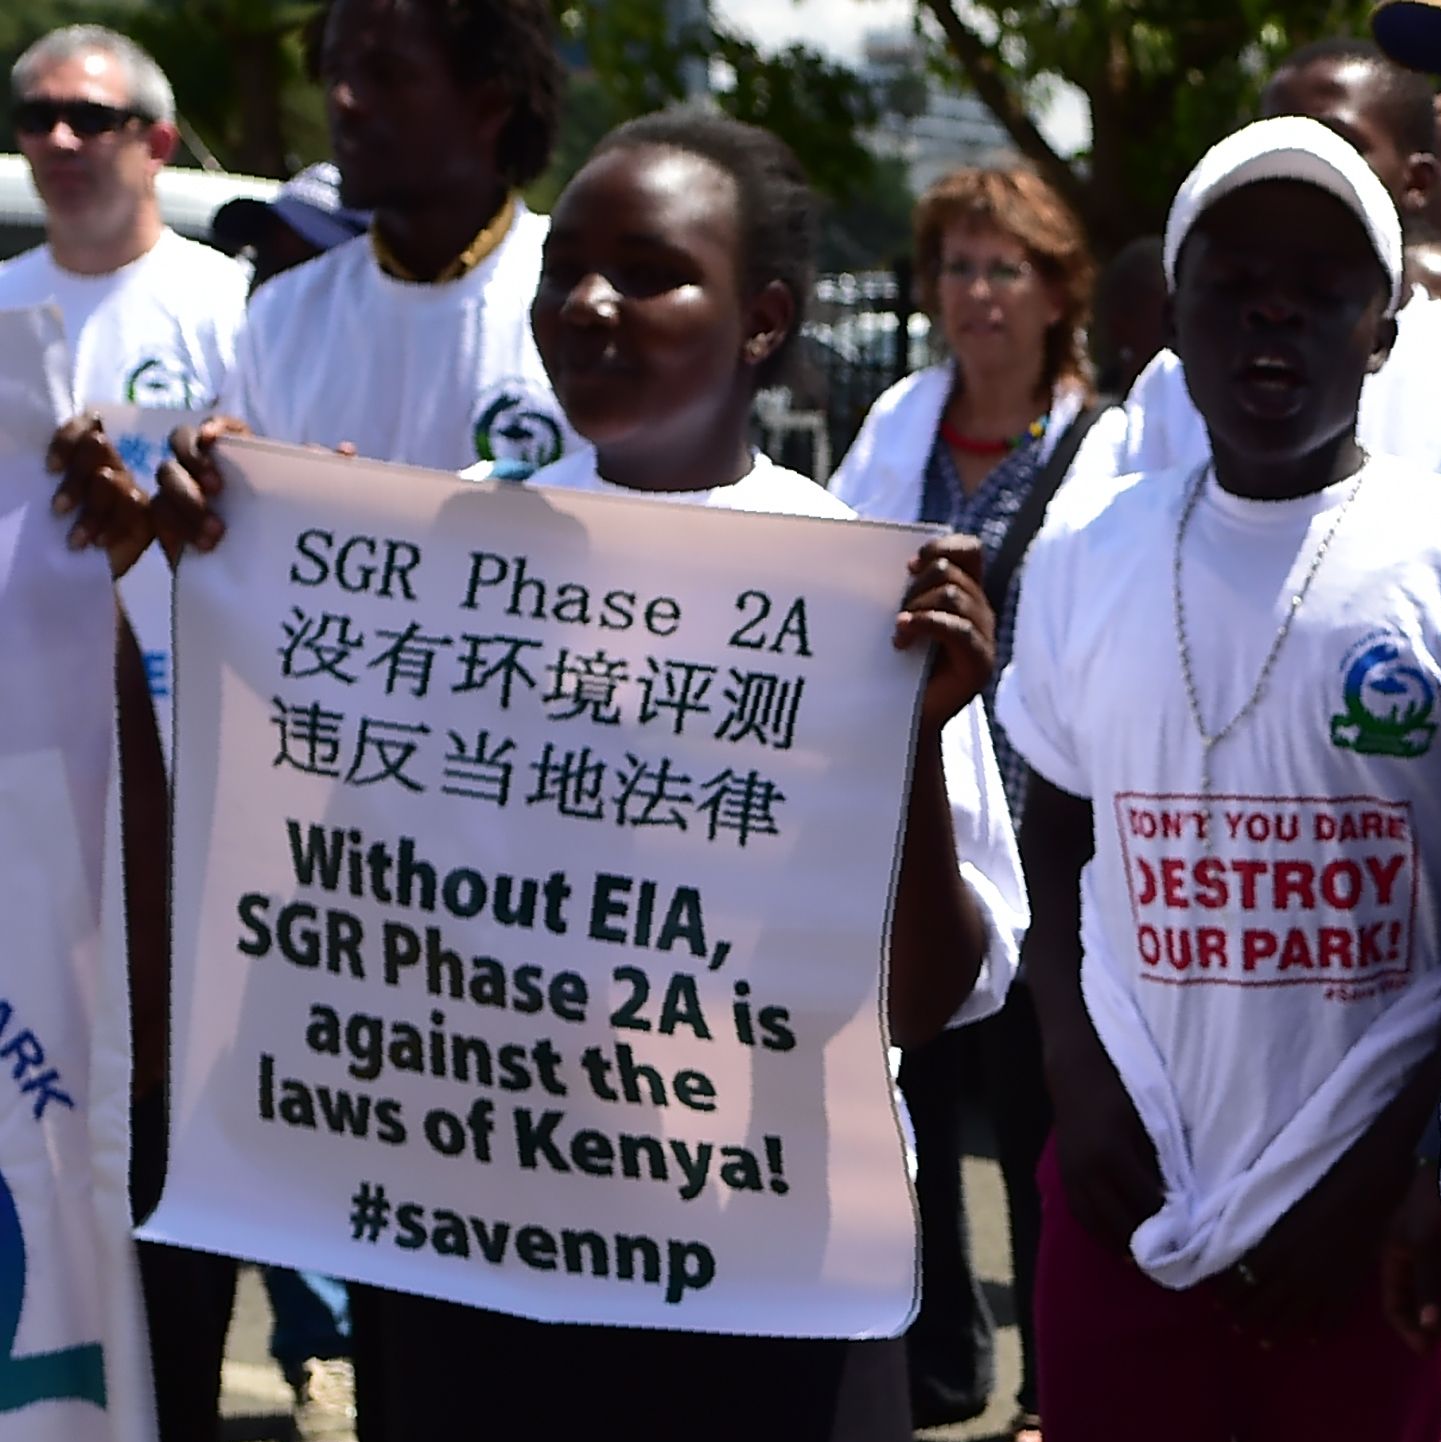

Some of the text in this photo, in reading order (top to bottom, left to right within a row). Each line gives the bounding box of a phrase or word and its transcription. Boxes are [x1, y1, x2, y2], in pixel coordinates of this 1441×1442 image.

[290, 529, 813, 657] SGR Phase 2A
[278, 605, 806, 751] 没有环境评测
[271, 696, 788, 848] 违反当地法律
[1225, 811, 1299, 843] YOU
[1313, 811, 1406, 843] DARE
[286, 819, 732, 972] Without EIA,
[1137, 921, 1402, 971] OUR PARK!
[237, 893, 797, 1053] SGR Phase 2A is
[305, 1003, 718, 1112] against the
[258, 1052, 791, 1203] laws of Kenya!
[349, 1181, 719, 1304] #savennp
